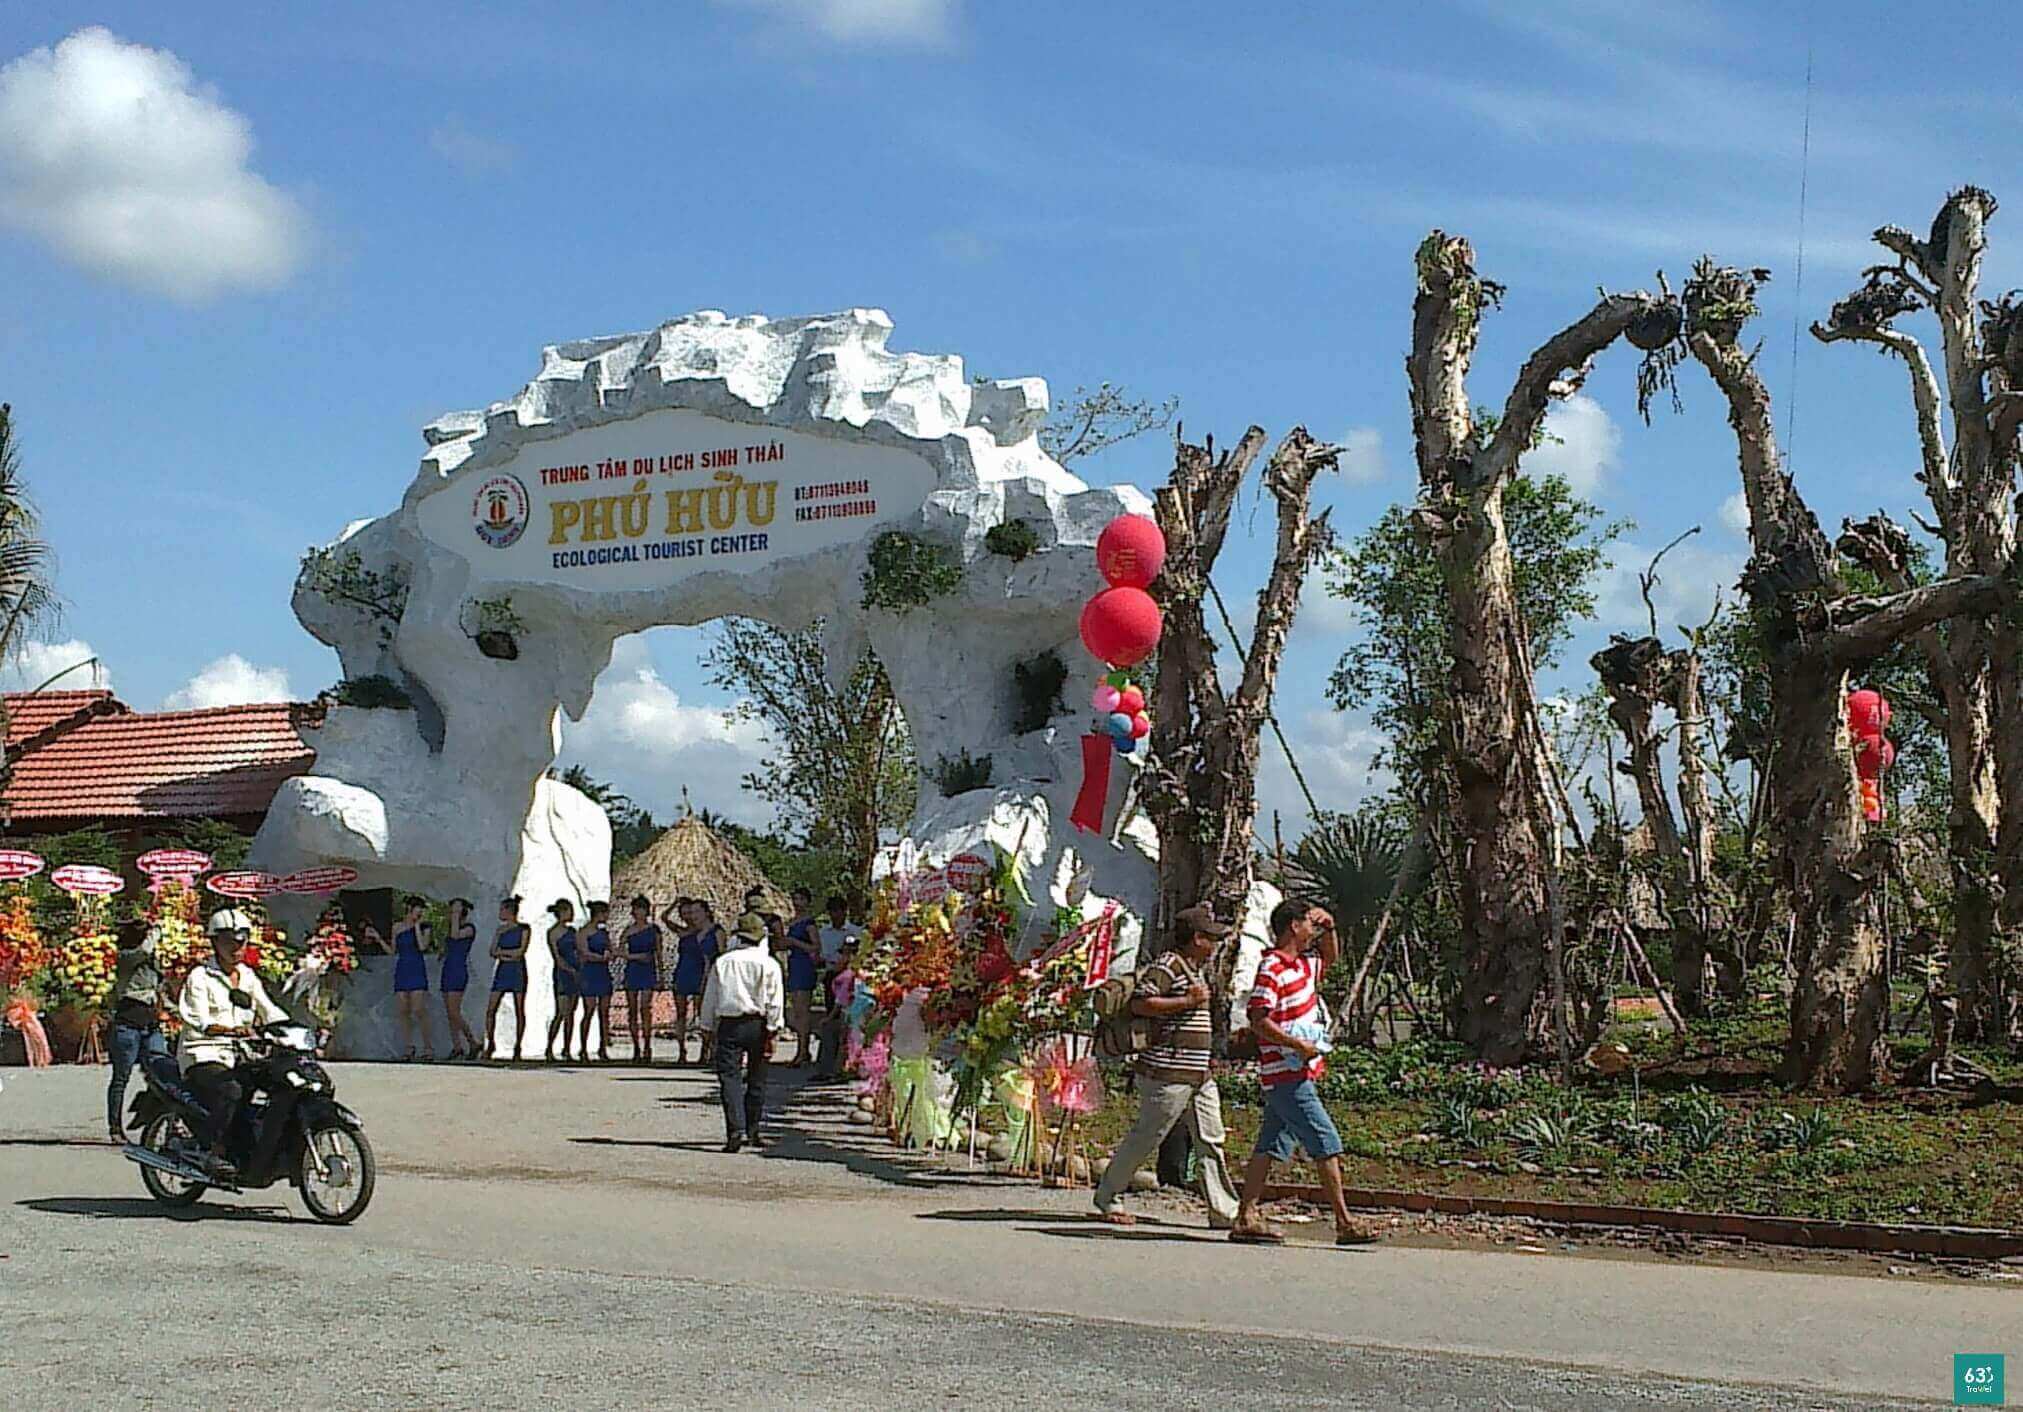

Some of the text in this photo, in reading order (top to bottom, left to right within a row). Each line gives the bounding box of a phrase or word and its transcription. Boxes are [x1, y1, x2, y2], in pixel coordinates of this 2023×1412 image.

[540, 464, 590, 486] TRUNG
[596, 457, 628, 480] TÂM
[633, 457, 654, 476] DU
[660, 453, 695, 478] LỊCH
[701, 448, 738, 468] SINH
[548, 478, 652, 545] PHÚ
[664, 469, 778, 535] HỮU
[552, 533, 768, 569] ECOLOGICAL TOURIST CENTER
